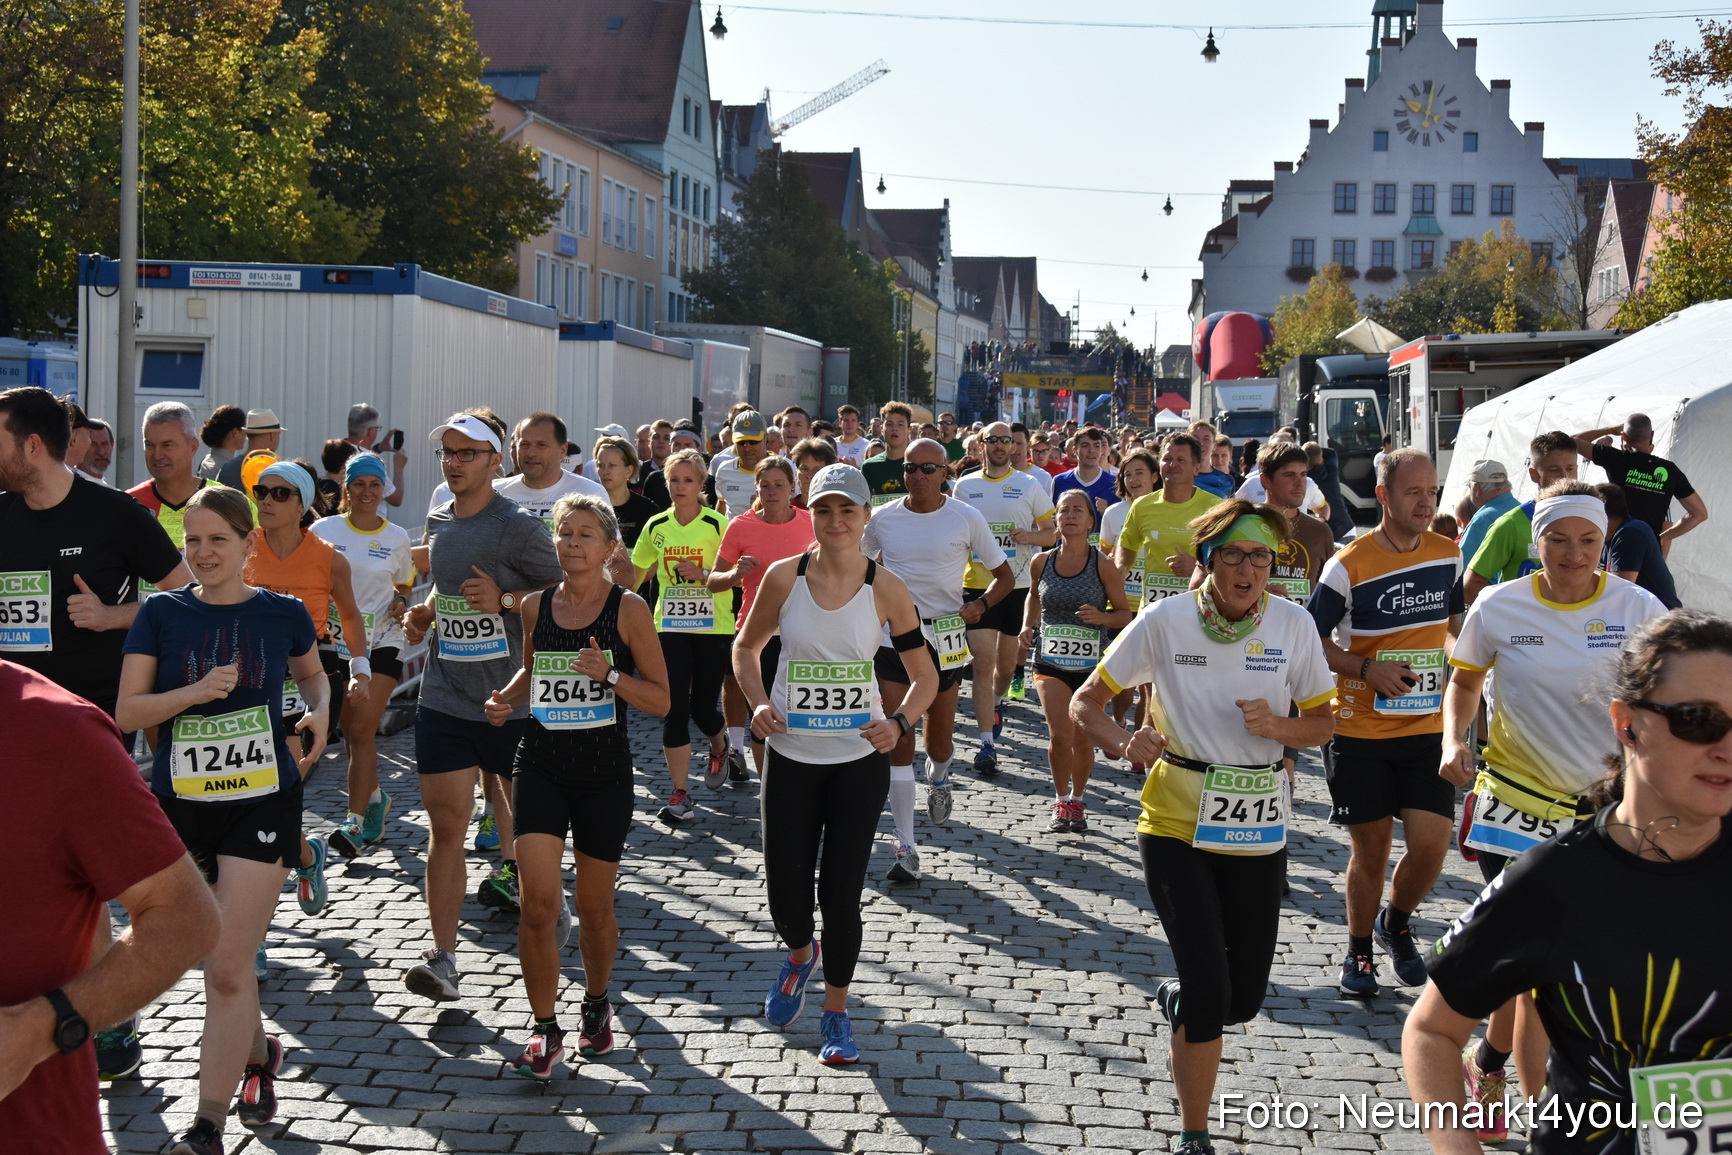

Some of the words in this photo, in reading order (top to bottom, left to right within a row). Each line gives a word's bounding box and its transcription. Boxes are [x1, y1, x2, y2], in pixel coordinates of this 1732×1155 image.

[225, 271, 240, 279] DIXI
[10, 368, 19, 376] 80
[1039, 376, 1077, 387] START
[1626, 468, 1653, 480] physio
[1625, 476, 1664, 490] neumarkt
[60, 547, 82, 556] TCA
[663, 546, 703, 556] Müller
[1276, 565, 1290, 577] ANA
[1291, 567, 1305, 578] JOE
[666, 587, 709, 598] BOCK
[1392, 588, 1445, 609] Fischer
[0, 600, 39, 624] 653
[667, 602, 708, 616] 2334
[1399, 602, 1444, 616] AUTOMOBILE
[441, 617, 495, 639] 2099
[671, 619, 704, 627] MONIKA
[1587, 622, 1605, 633] 20
[0, 631, 31, 642] ULIAN
[1048, 626, 1095, 639] BOCK
[1511, 635, 1543, 643] BOCK
[444, 641, 499, 652] CHRISTOPHER
[1048, 640, 1093, 656] 2329
[1246, 643, 1264, 655] 20
[1053, 658, 1086, 666] SABINE
[1174, 654, 1207, 663] BOCK
[1245, 656, 1287, 664] Neumarkter
[793, 663, 867, 681] BOCK
[1245, 664, 1279, 673] Stadtlauf
[1418, 671, 1437, 692] 13
[539, 680, 605, 703] 2645
[796, 687, 863, 711] 2332
[1386, 697, 1434, 708] STEPHAN
[547, 709, 596, 721] GISELA
[178, 710, 264, 739] BOCK
[808, 717, 852, 728] KLAUS
[183, 740, 265, 773] 1244
[204, 777, 249, 792] ANNA
[1210, 796, 1279, 823] 2415
[1482, 795, 1560, 839] 2795
[1224, 831, 1263, 841] ROSA
[1647, 1067, 1732, 1112] BO
